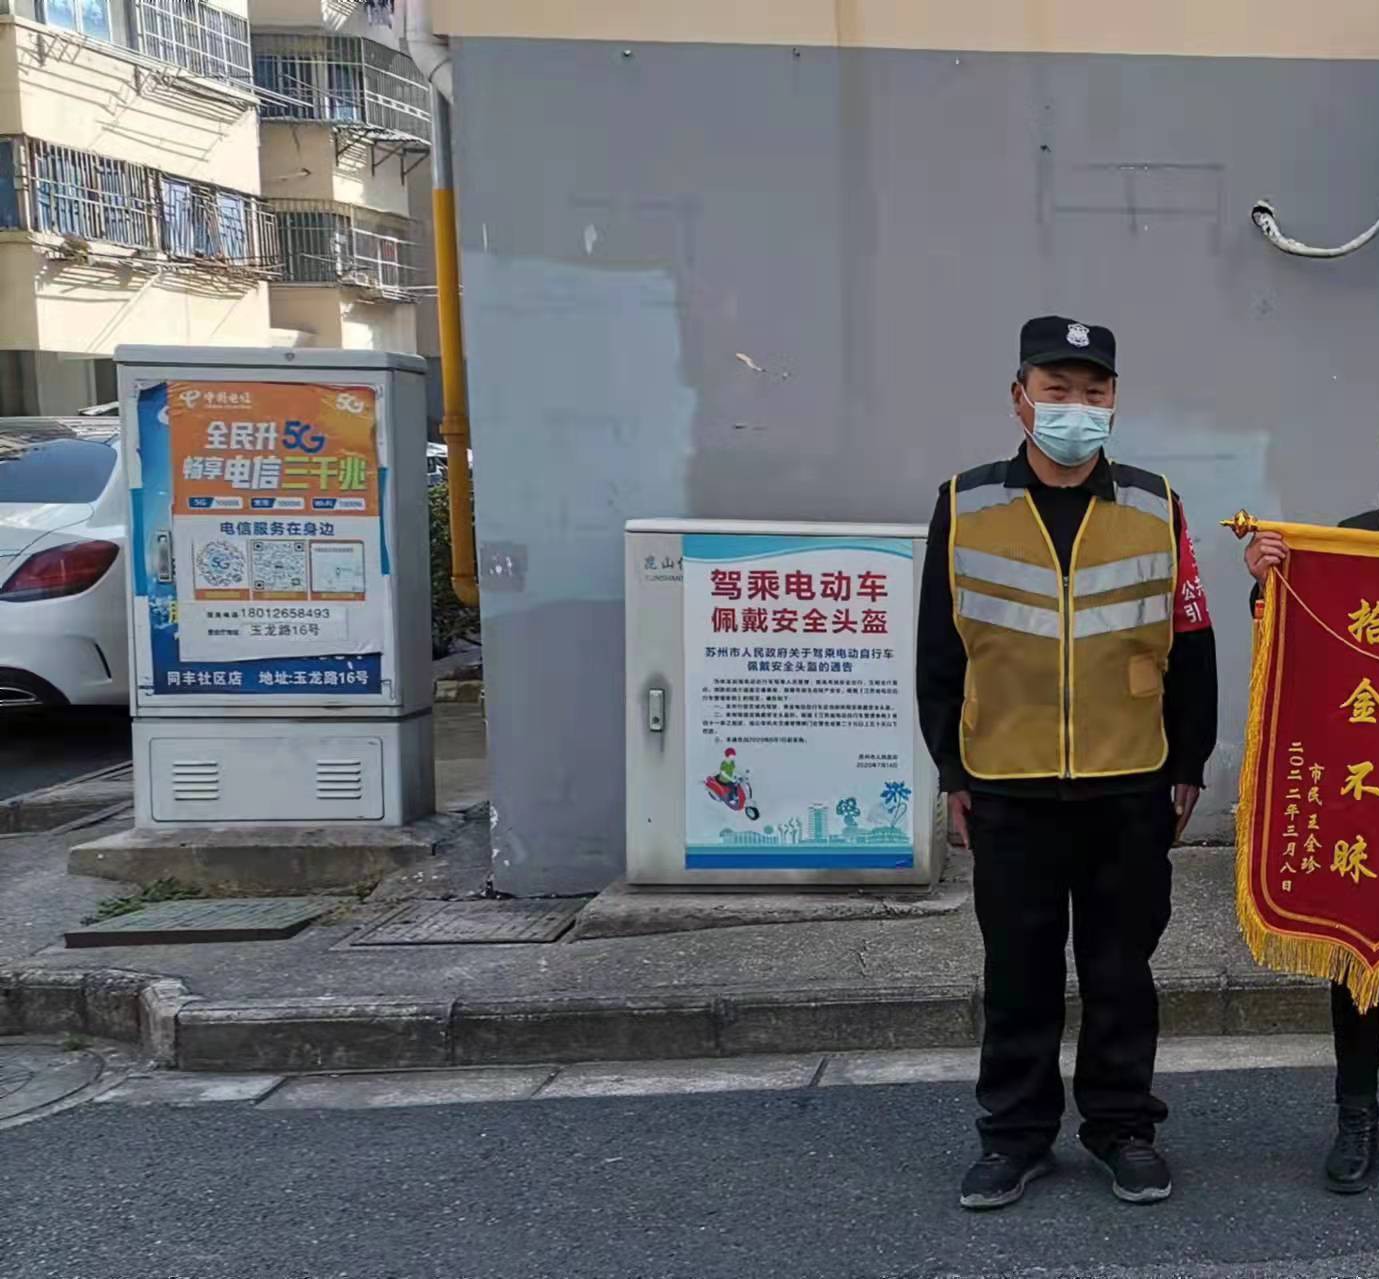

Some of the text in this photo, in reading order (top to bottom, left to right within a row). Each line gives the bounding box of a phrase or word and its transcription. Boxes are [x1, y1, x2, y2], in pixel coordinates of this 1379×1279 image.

[335, 393, 364, 413] 5G
[205, 420, 326, 454] 全民升5G
[183, 455, 368, 490] 畅享电信三千兆
[220, 521, 335, 537] 电信服务在身边
[710, 569, 888, 602] 驾乘电动车
[241, 608, 330, 619] 18012658493
[711, 607, 888, 634] 佩戴安全头盔
[250, 624, 320, 636] 玉龙路16号
[705, 647, 894, 659] 苏州市人民政府关于驾乘电动自行车
[747, 661, 853, 673] 佩戴安全头盔的通告
[167, 671, 242, 686] 同丰社区店
